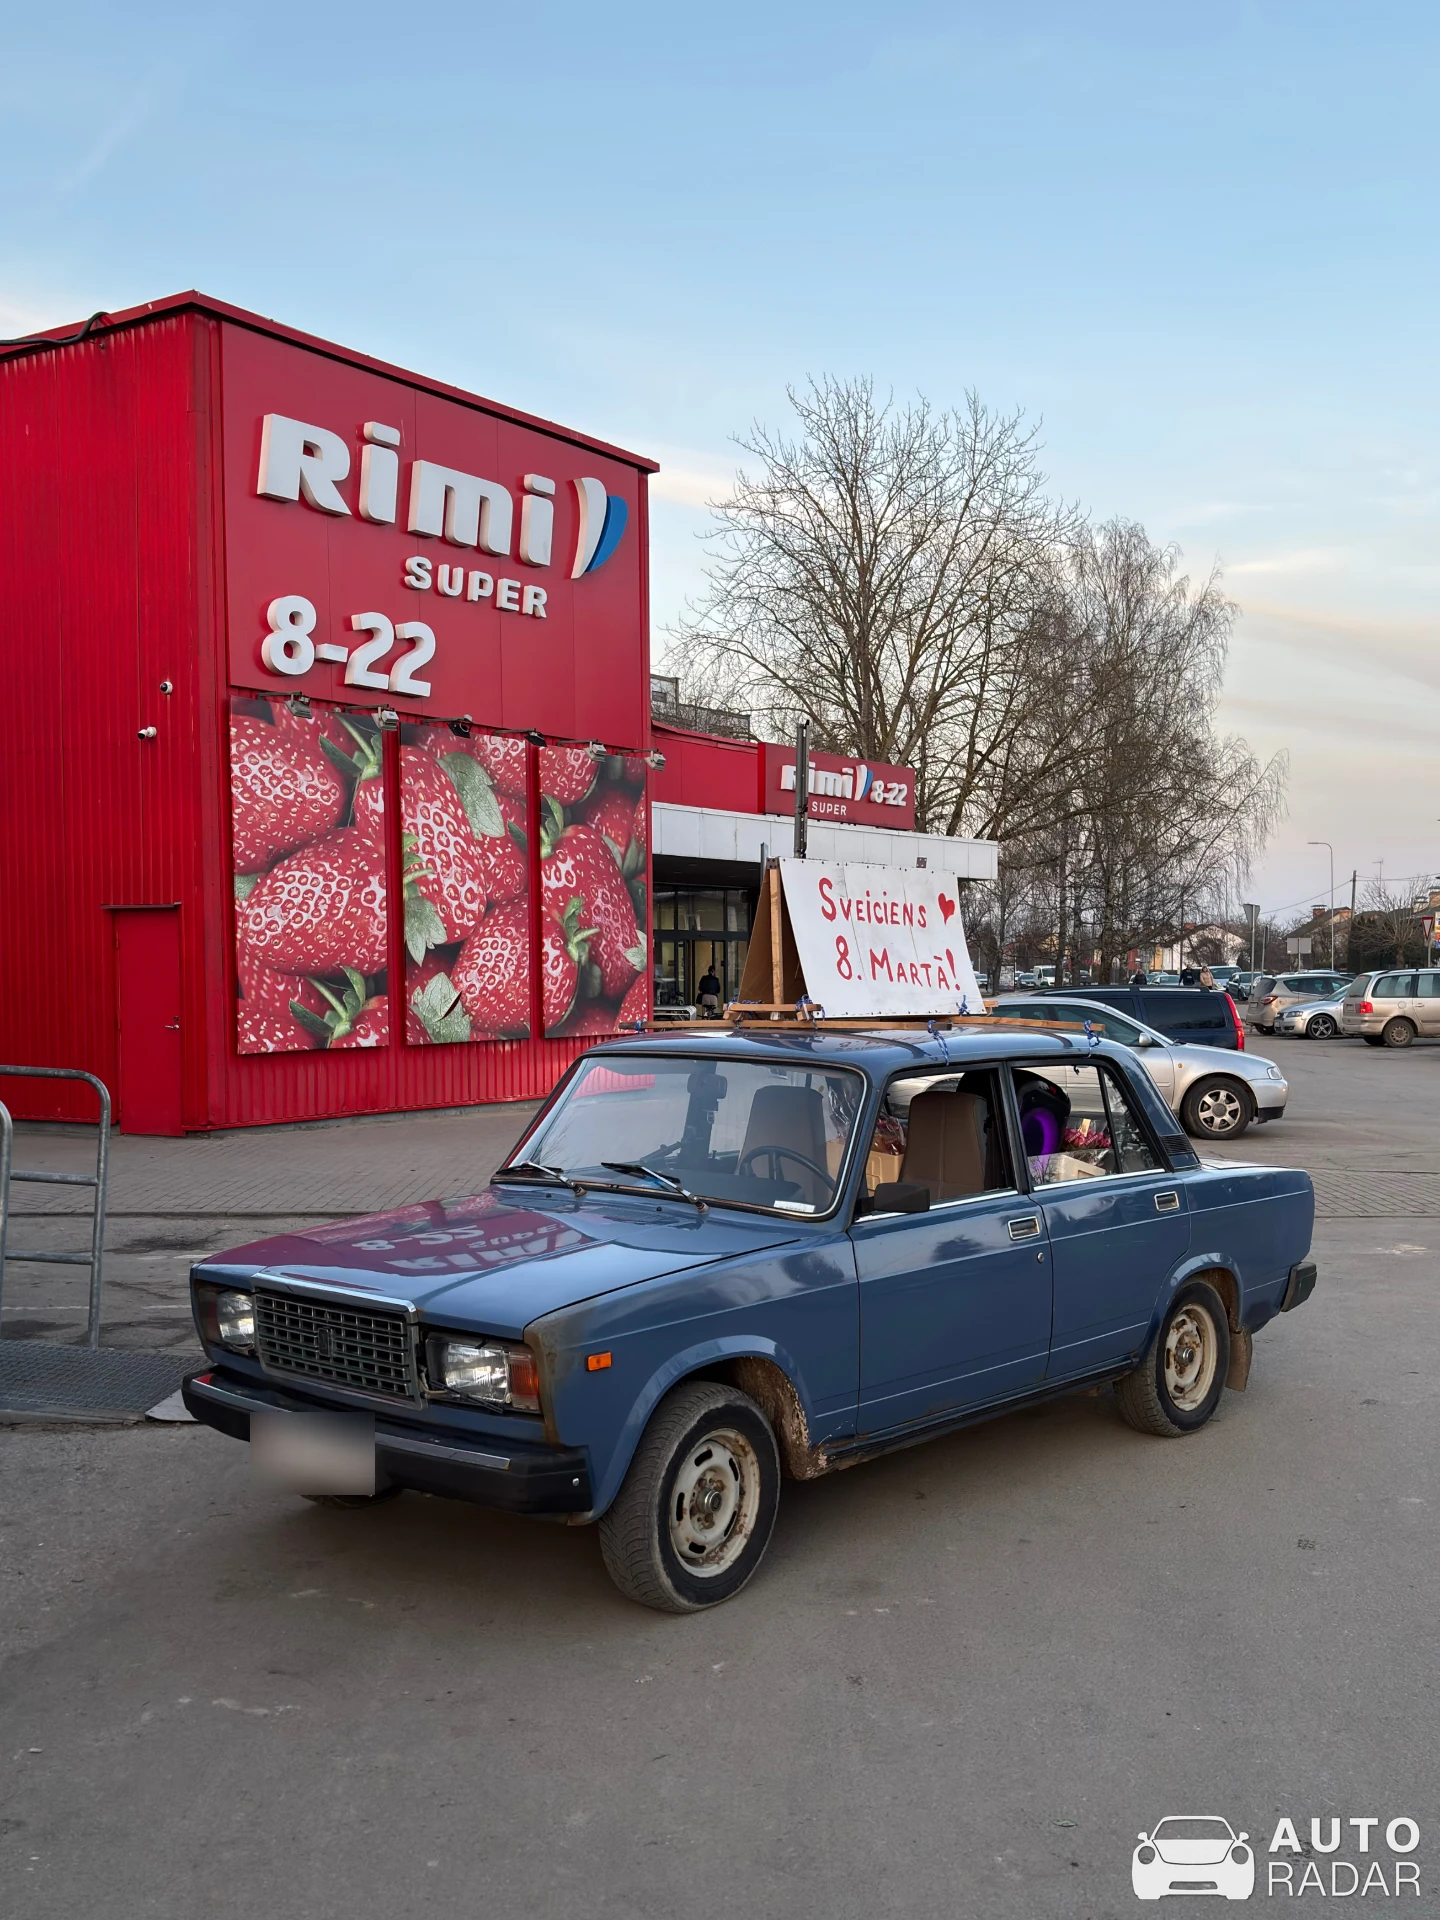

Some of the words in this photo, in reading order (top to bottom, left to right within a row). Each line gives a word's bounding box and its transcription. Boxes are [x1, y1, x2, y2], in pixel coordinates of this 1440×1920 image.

[257, 413, 555, 567] Rimi
[404, 556, 547, 618] SUPER
[261, 595, 436, 697] 8-22
[811, 801, 847, 816] SUPER
[870, 780, 908, 806] 8-22
[835, 935, 862, 980] 8.
